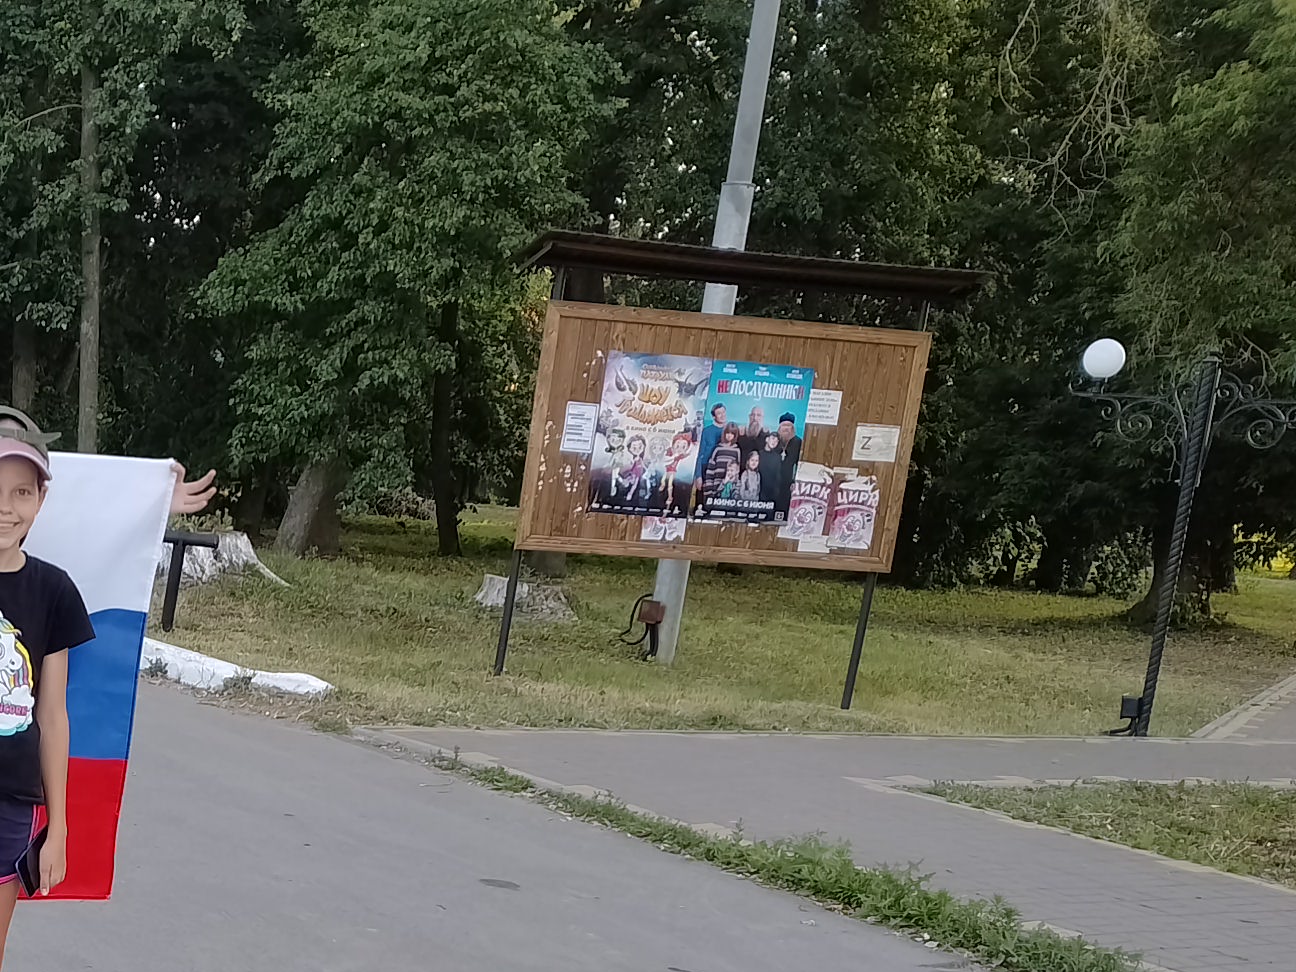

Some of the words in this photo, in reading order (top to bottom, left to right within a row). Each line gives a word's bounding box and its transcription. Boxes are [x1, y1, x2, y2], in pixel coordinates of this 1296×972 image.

[860, 436, 873, 450] Z
[706, 497, 714, 505] В
[713, 498, 737, 508] КИНО
[749, 501, 775, 510] ИЮНЯ
